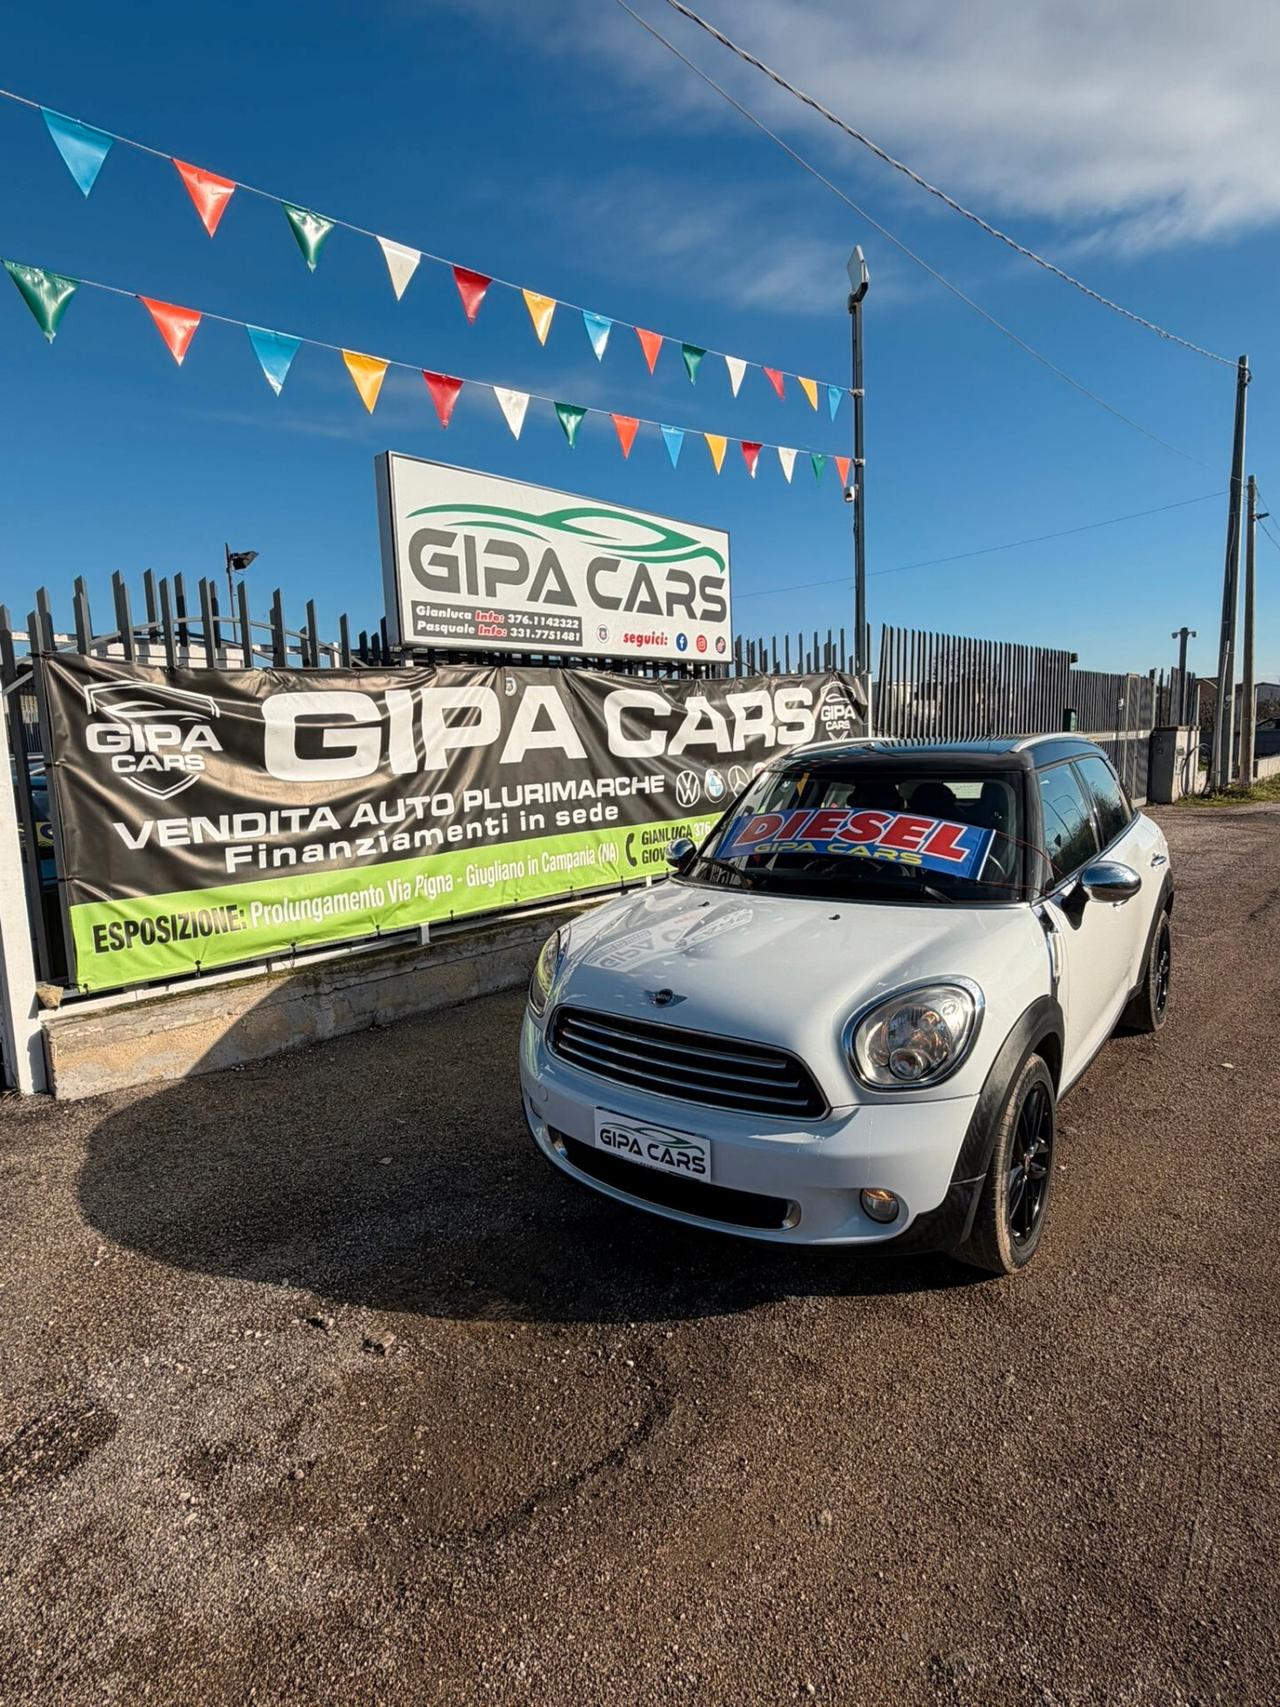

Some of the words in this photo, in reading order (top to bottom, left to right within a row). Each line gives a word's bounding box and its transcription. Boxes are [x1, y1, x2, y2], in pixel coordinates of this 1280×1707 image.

[408, 527, 577, 607] GIPA
[586, 556, 727, 623] CARS
[416, 605, 472, 620] Gianluca
[475, 609, 505, 623] Info:
[507, 614, 579, 629] 376.1142322
[417, 620, 475, 635] Pasquale
[477, 624, 508, 637] Info:
[510, 628, 580, 641] 331.7751481
[623, 631, 669, 647] seguici:
[820, 704, 856, 721] GIPA
[85, 722, 224, 753] GIPA
[262, 684, 587, 782] GIPA
[604, 686, 815, 758] CARS
[825, 720, 850, 731] CARS
[111, 754, 206, 774] CARS
[113, 805, 341, 850] VENDITA
[350, 791, 455, 828] AUTO
[463, 774, 665, 813] PLURIMARCHE
[225, 812, 509, 874] Finanziamenti
[520, 808, 545, 832] in
[555, 803, 620, 826] sede
[641, 824, 693, 846] GIANLUCA
[693, 821, 711, 837] 376
[732, 808, 970, 863] DIESEL
[641, 847, 667, 864] GIOV
[754, 841, 813, 854] GIPA
[827, 843, 922, 866] CARS
[92, 904, 249, 954] ESPOSIZIONE:
[250, 884, 385, 928] Prolungamento
[387, 876, 412, 902] Via
[414, 872, 454, 902] Pigna
[465, 858, 525, 890] Giugliano
[528, 854, 539, 875] in
[542, 848, 596, 873] Campania
[597, 840, 619, 867] (NA)
[599, 1127, 644, 1157] GIPA
[647, 1142, 706, 1175] CARS
